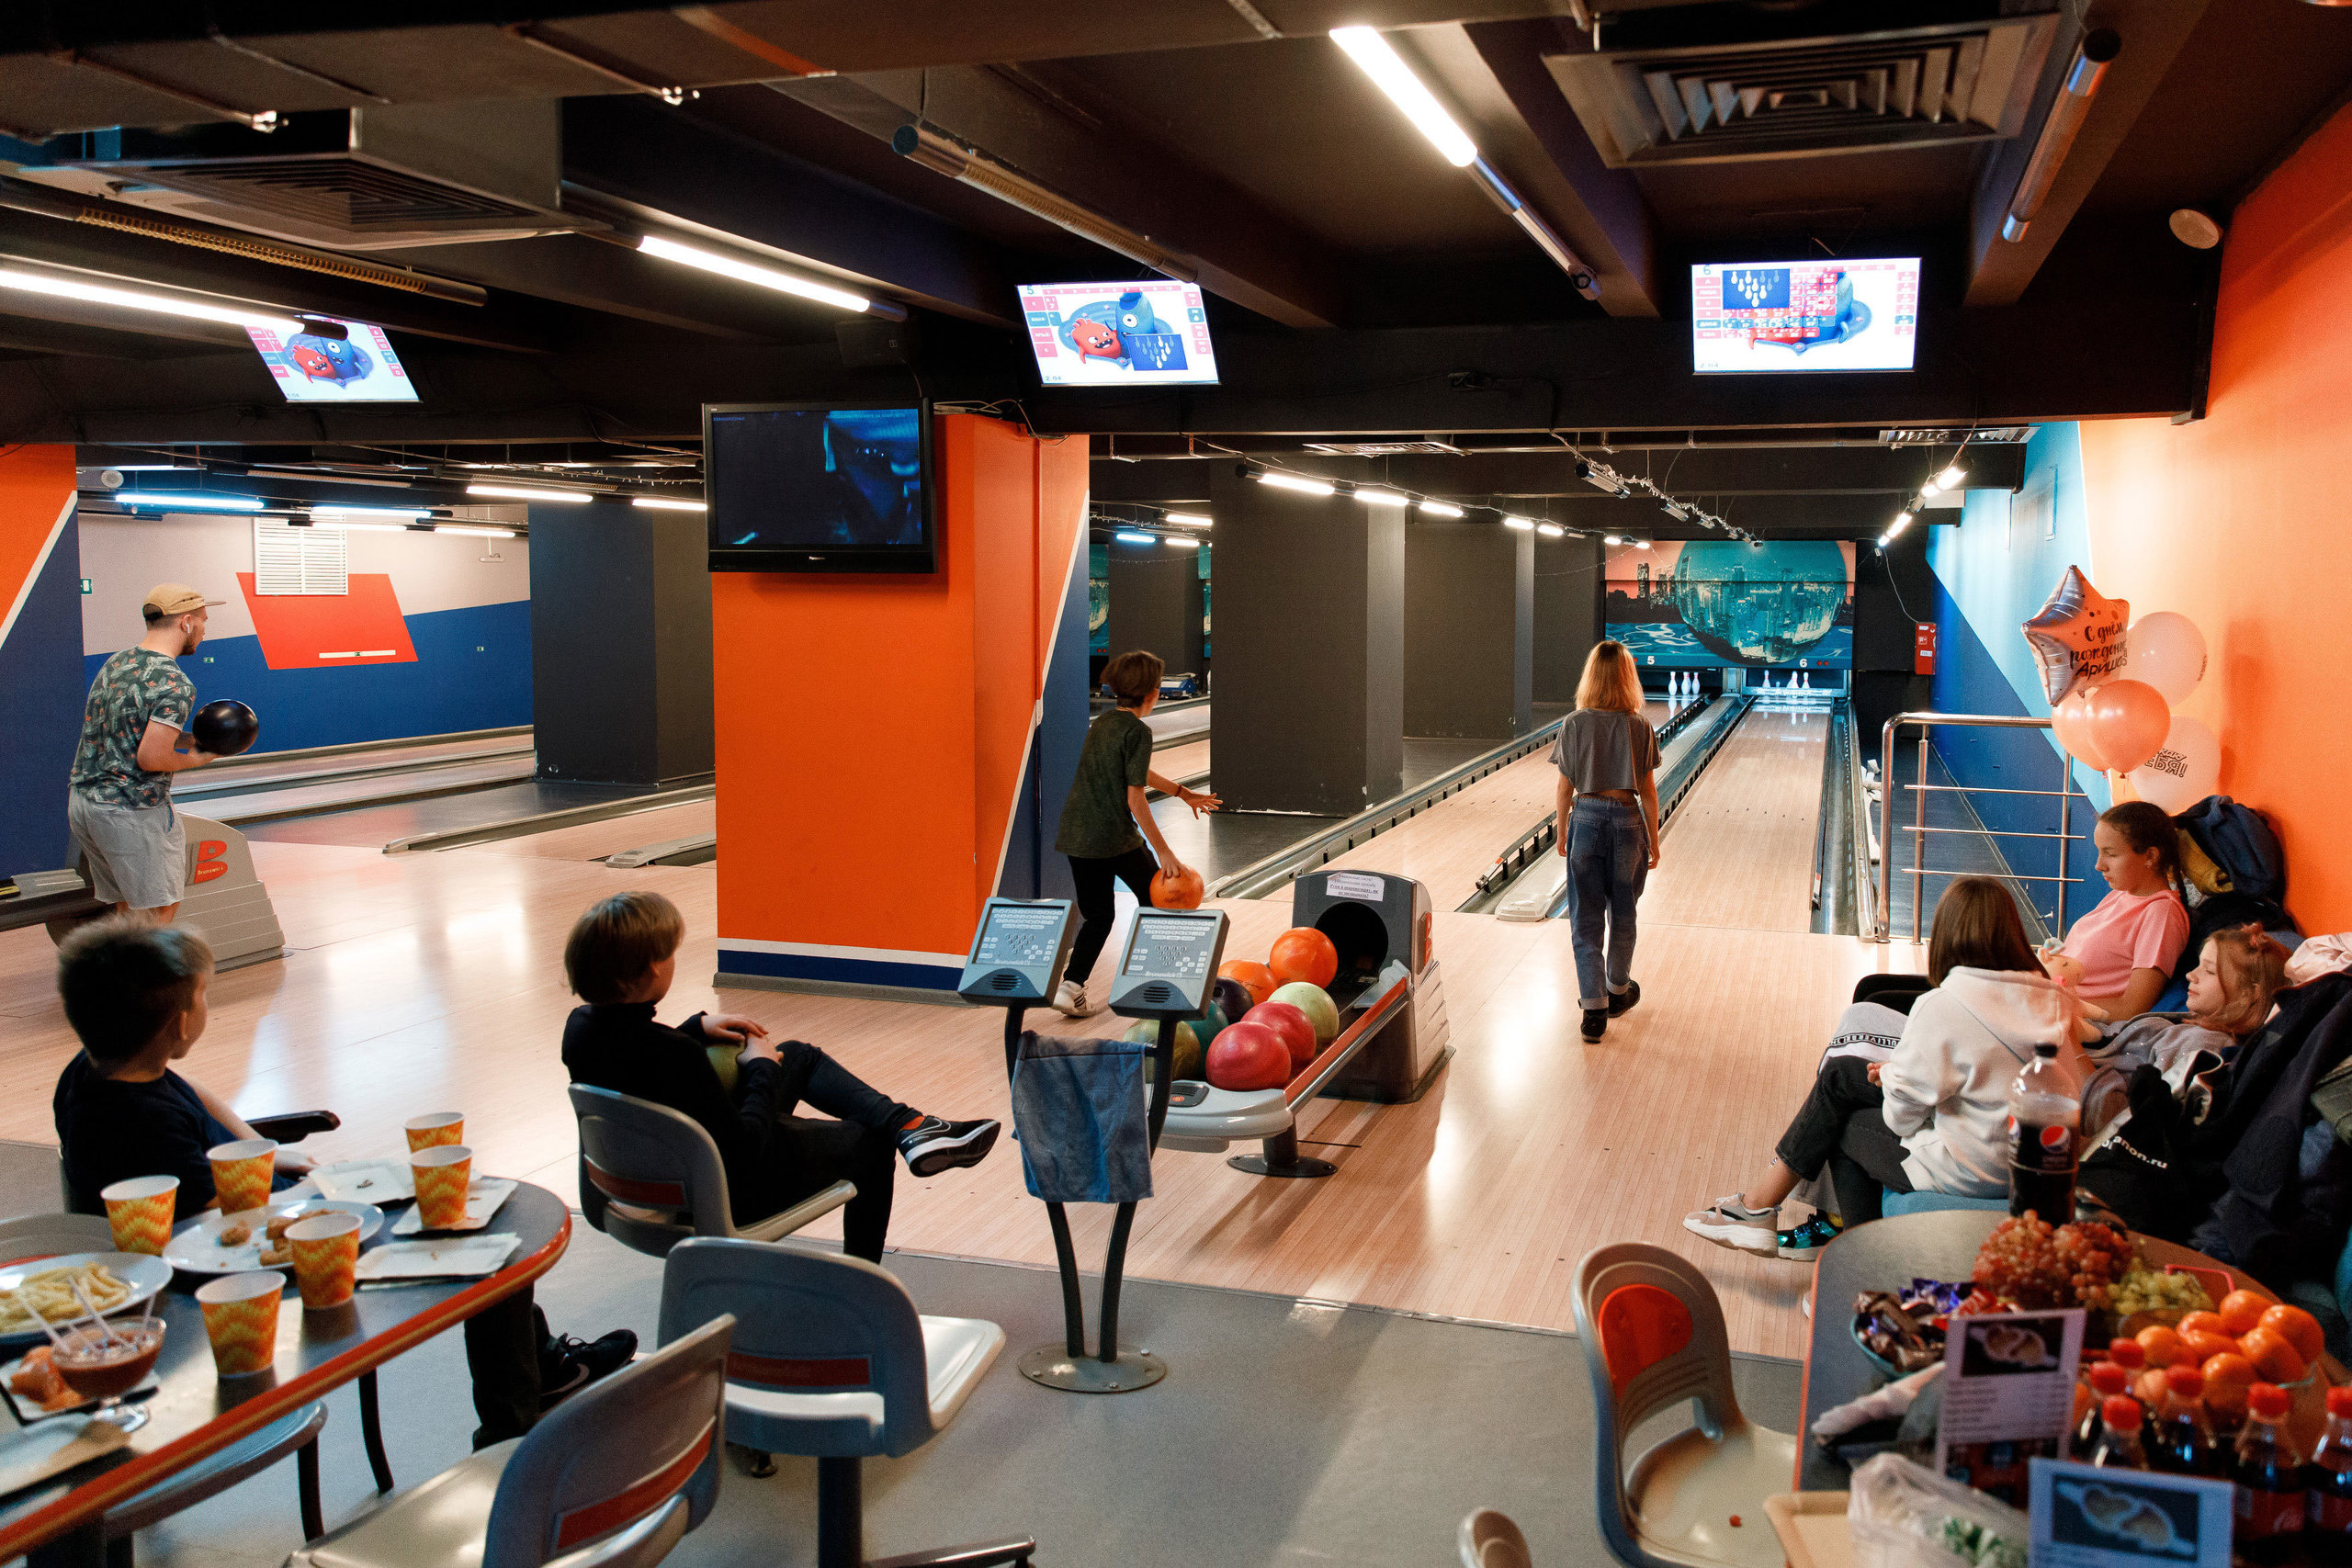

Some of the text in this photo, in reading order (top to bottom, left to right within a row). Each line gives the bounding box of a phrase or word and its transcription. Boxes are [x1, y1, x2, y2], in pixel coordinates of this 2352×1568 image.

[1026, 285, 1035, 295] 5
[1646, 655, 1656, 665] 5
[1799, 658, 1808, 668] 6
[2144, 756, 2188, 778] ЕБЯ!
[994, 958, 1024, 966] Brunswick
